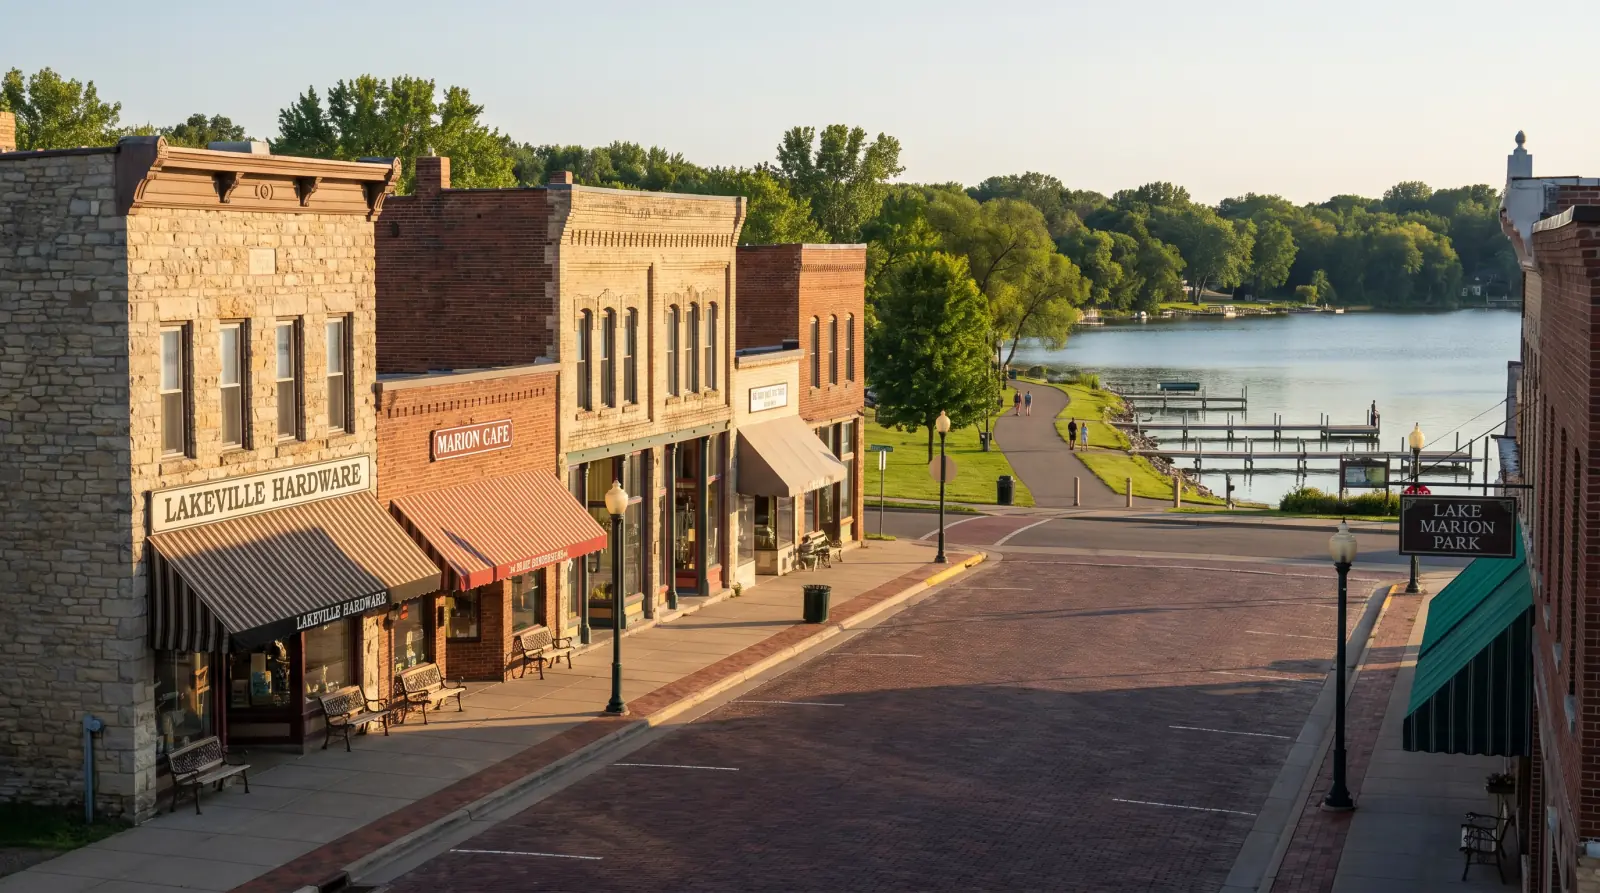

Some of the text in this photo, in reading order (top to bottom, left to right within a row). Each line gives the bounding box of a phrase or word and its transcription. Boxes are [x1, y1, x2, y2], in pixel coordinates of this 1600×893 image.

[437, 424, 510, 454] MARION CAFE
[164, 463, 362, 523] LAKEVILLE HARDWARE
[1433, 503, 1482, 518] LAKE
[1420, 519, 1495, 534] MARION
[1433, 535, 1481, 550] PARK
[296, 592, 387, 630] LAKEVILLE HARDWARE
